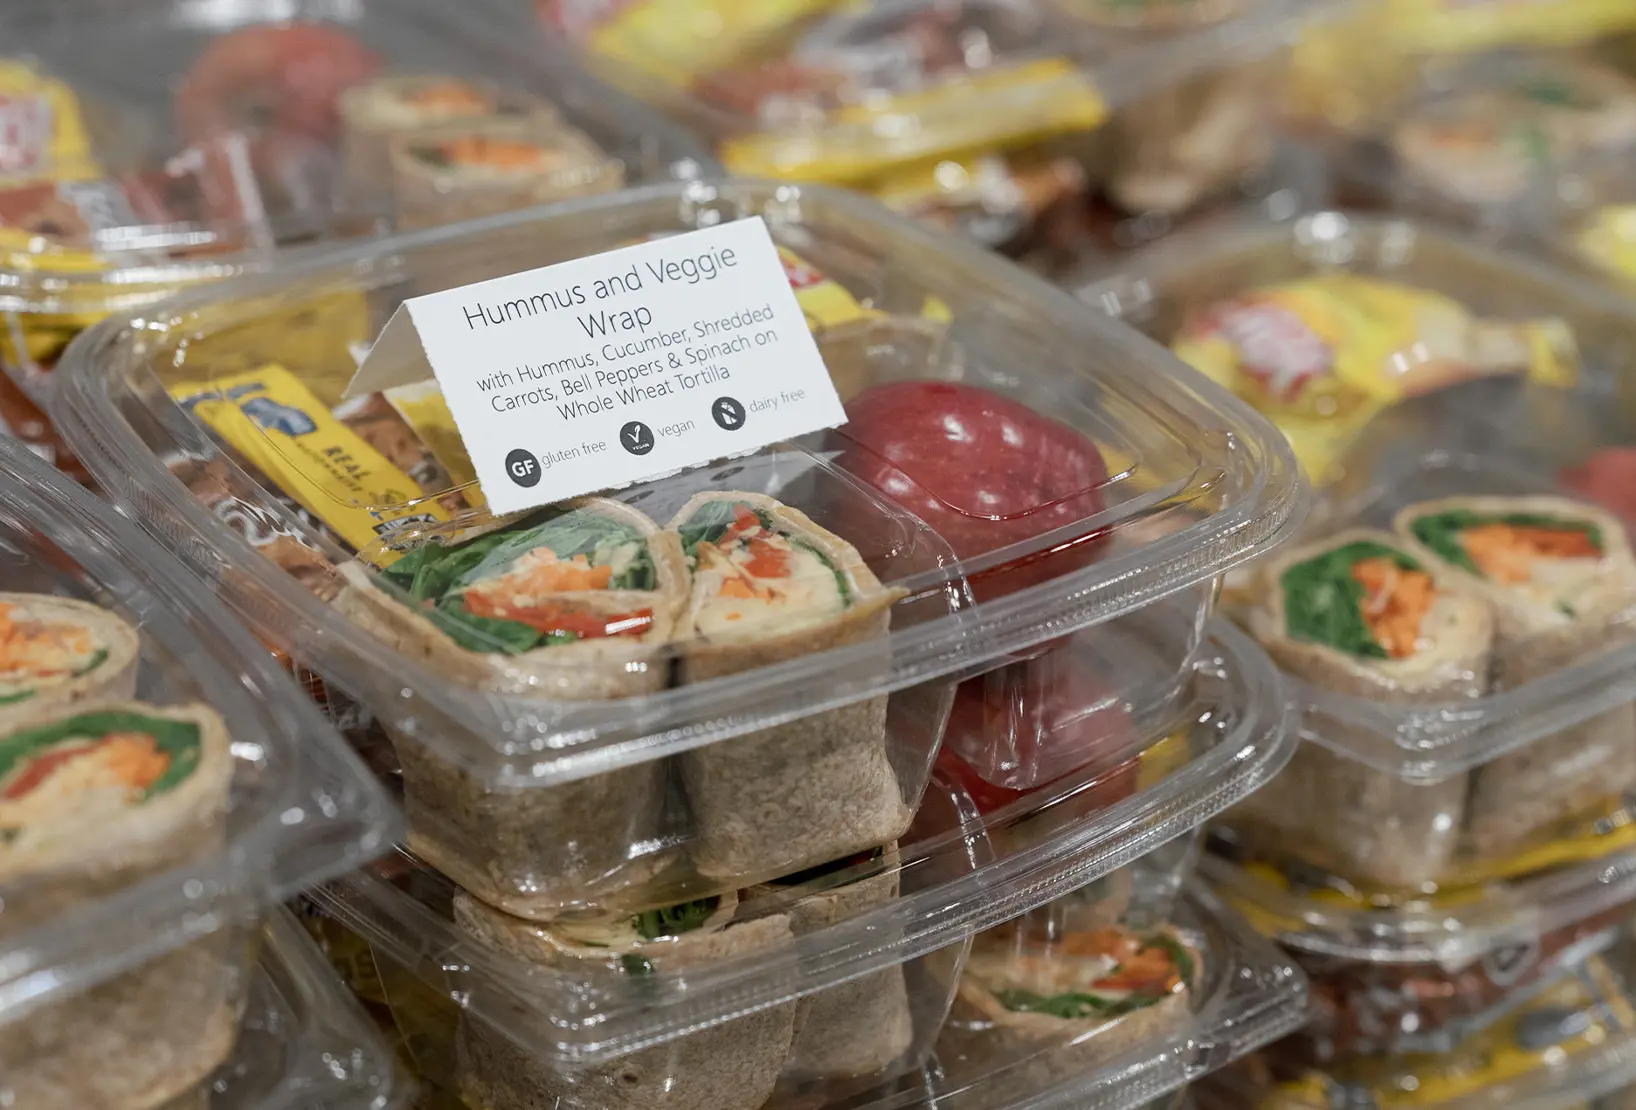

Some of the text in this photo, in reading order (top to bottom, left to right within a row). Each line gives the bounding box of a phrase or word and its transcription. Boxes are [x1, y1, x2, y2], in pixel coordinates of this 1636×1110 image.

[463, 246, 737, 330] Hummus and Veggie
[577, 307, 652, 338] Wrap
[476, 304, 774, 391] with Hummus, Cucumber, Shredded
[491, 330, 777, 412] Carrots, Bell Peppers & Spinach on
[556, 364, 730, 420] Whole Wheat Tortilla
[750, 388, 805, 414] dairy free
[657, 420, 695, 437] vegan
[541, 438, 607, 469] gluten free
[632, 442, 650, 451] VEGAN
[511, 459, 536, 477] GF
